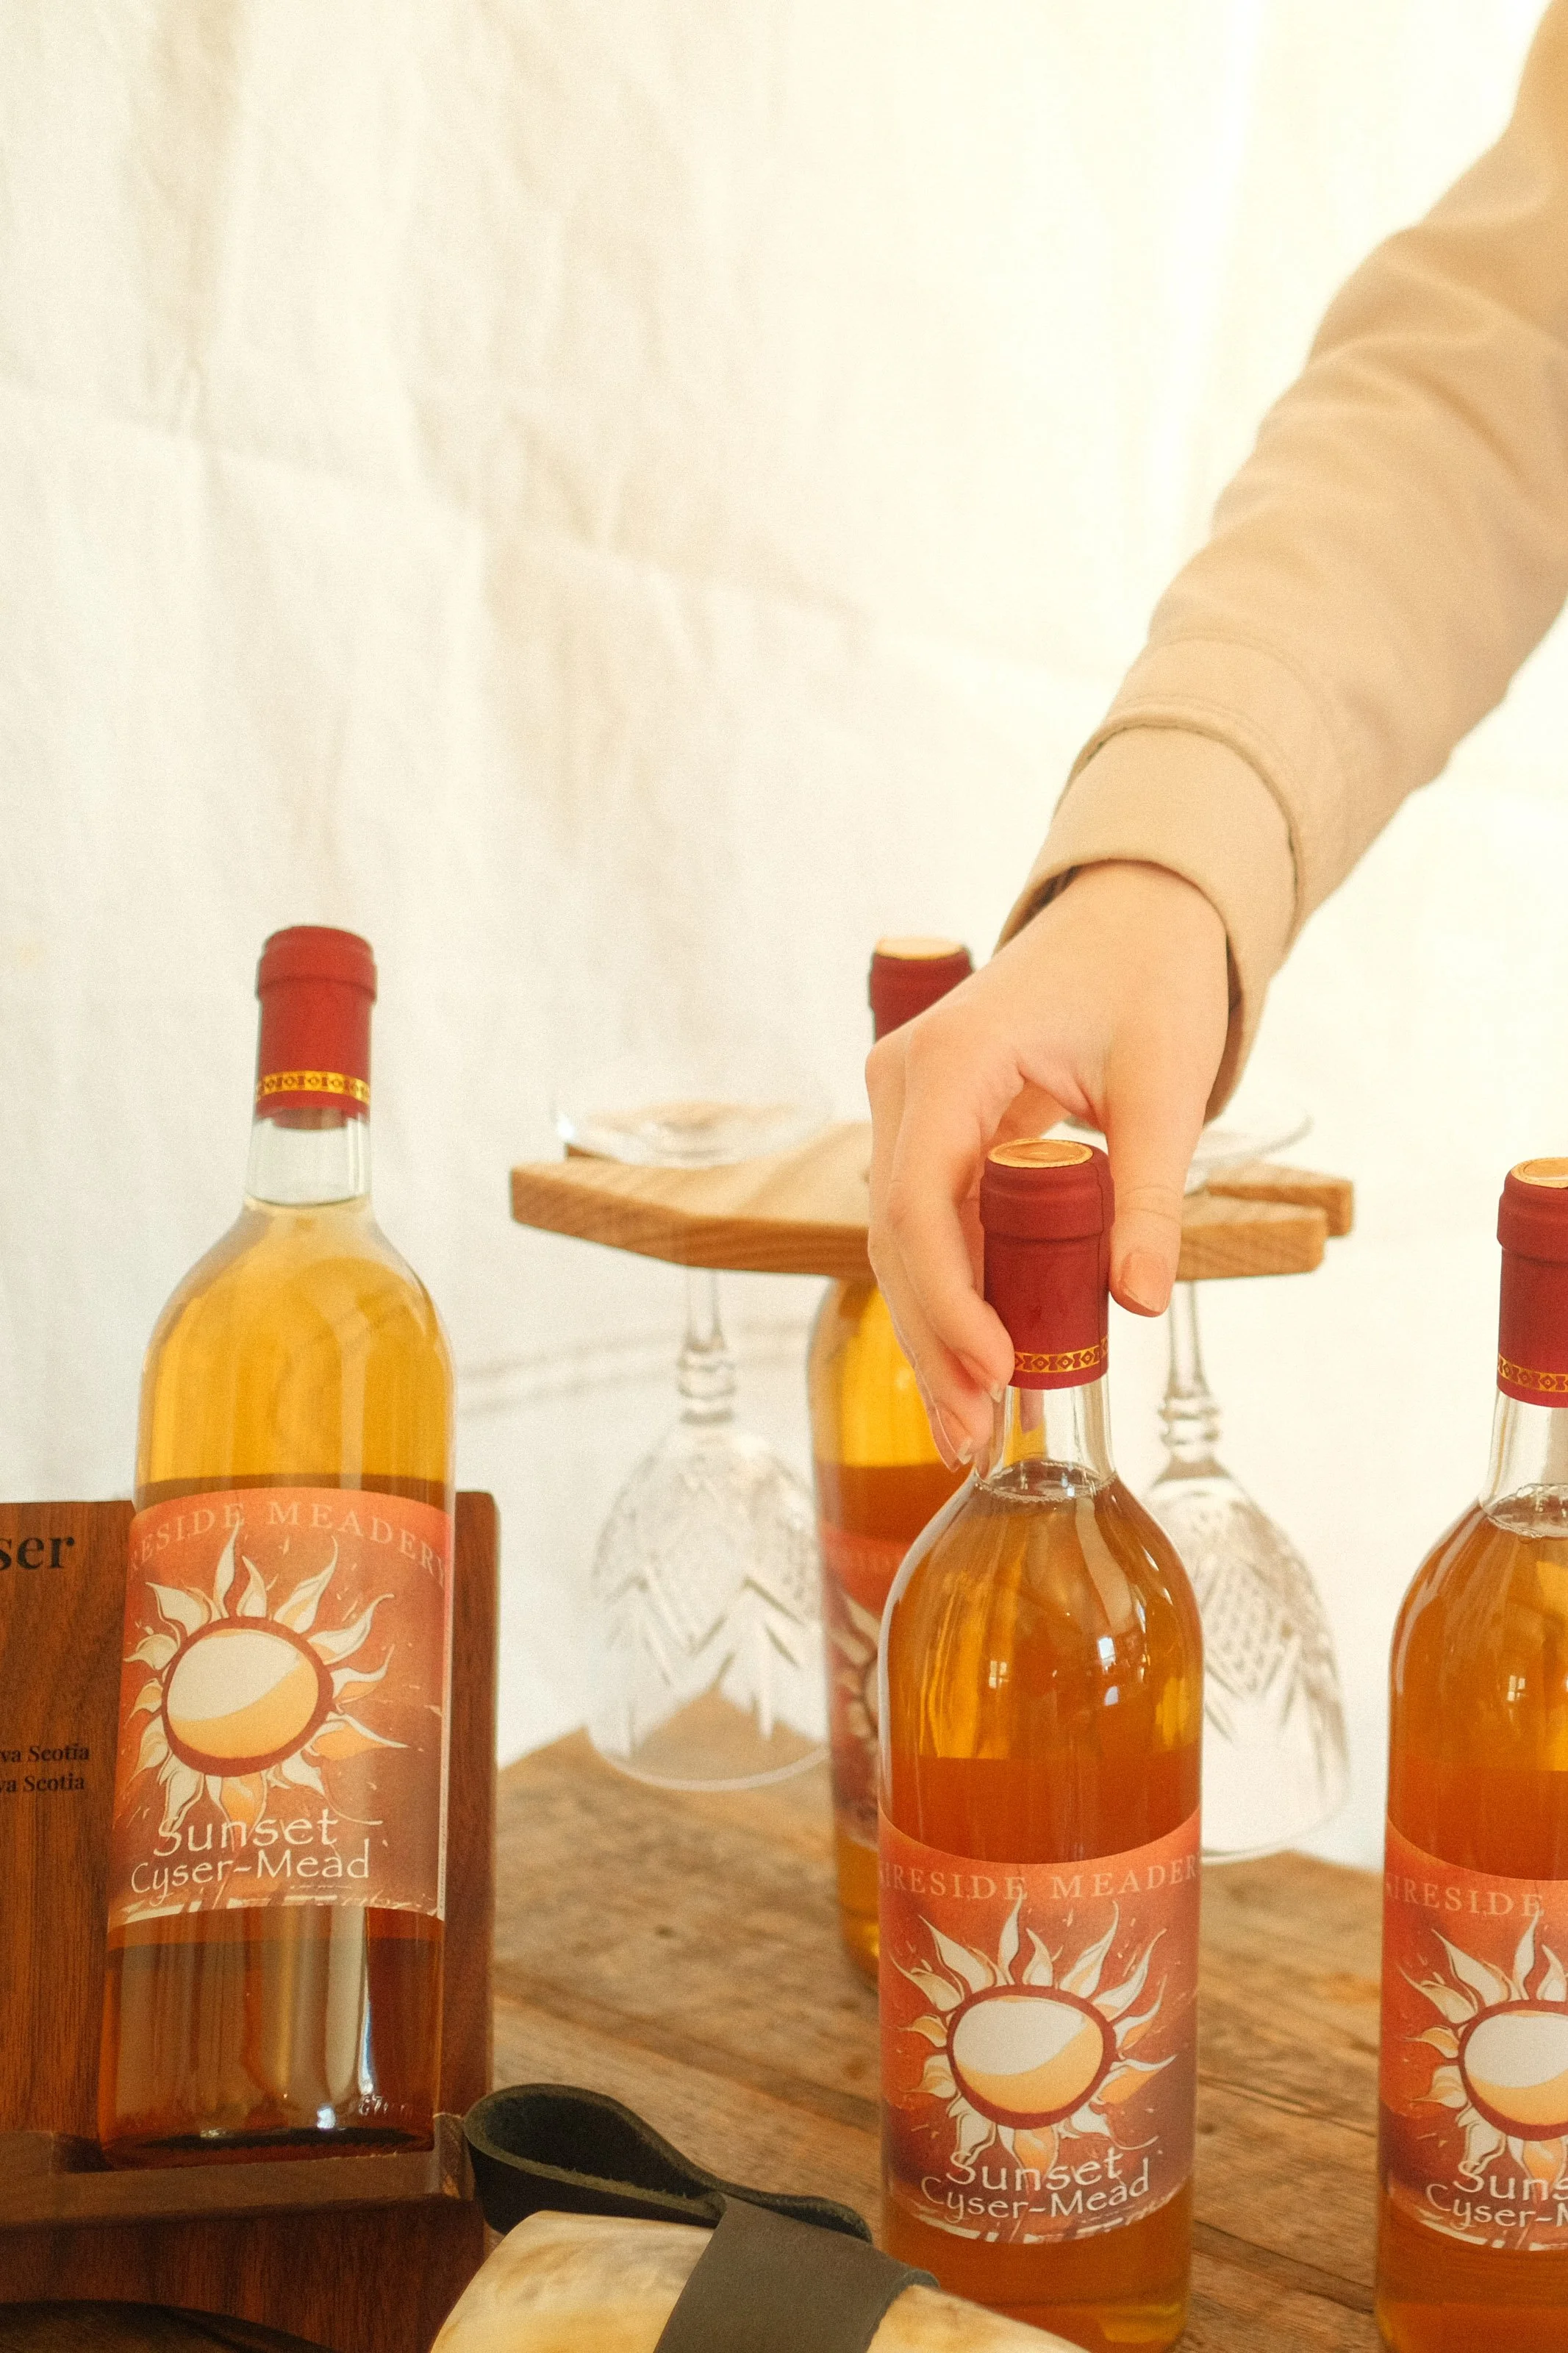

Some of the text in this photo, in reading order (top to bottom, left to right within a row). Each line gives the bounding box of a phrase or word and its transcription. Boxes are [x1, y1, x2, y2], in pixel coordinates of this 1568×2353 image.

[0, 1537, 75, 1571] ser
[28, 1743, 90, 1763] Scotia
[23, 1773, 85, 1793] Scotia
[153, 1808, 339, 1857] Sunset
[131, 1838, 370, 1907] Cyser-Mead
[921, 2157, 1149, 2224] Cyser-Mead
[946, 2146, 1124, 2191] Sunset
